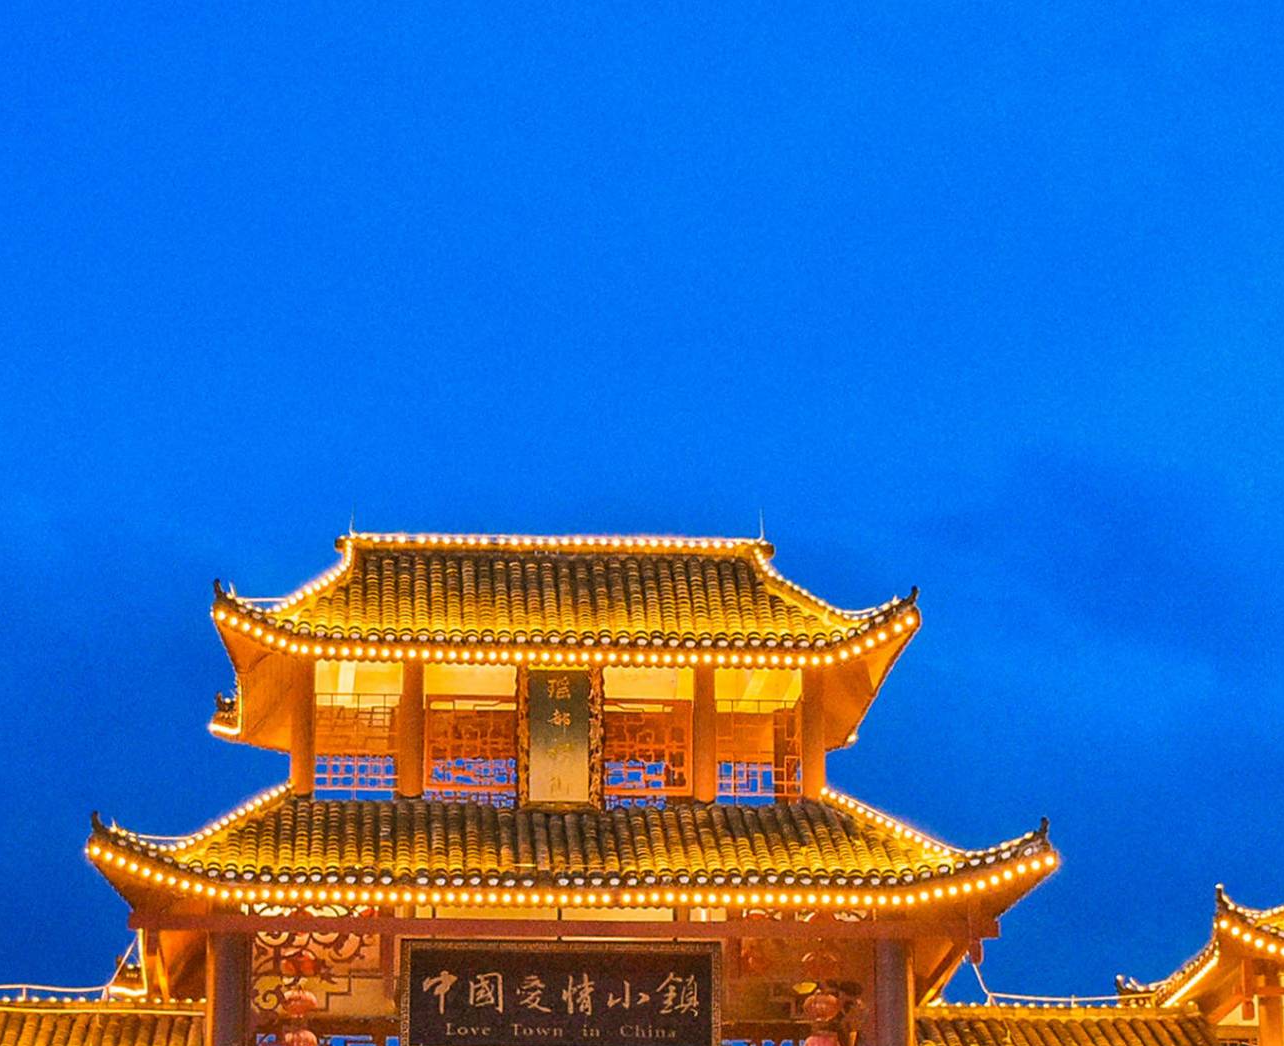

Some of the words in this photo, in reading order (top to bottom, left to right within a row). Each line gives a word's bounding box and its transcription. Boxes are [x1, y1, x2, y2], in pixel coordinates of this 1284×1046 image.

[445, 1022, 491, 1037] Love
[511, 1023, 564, 1038] Town
[582, 1024, 601, 1037] in
[619, 1023, 677, 1039] China
